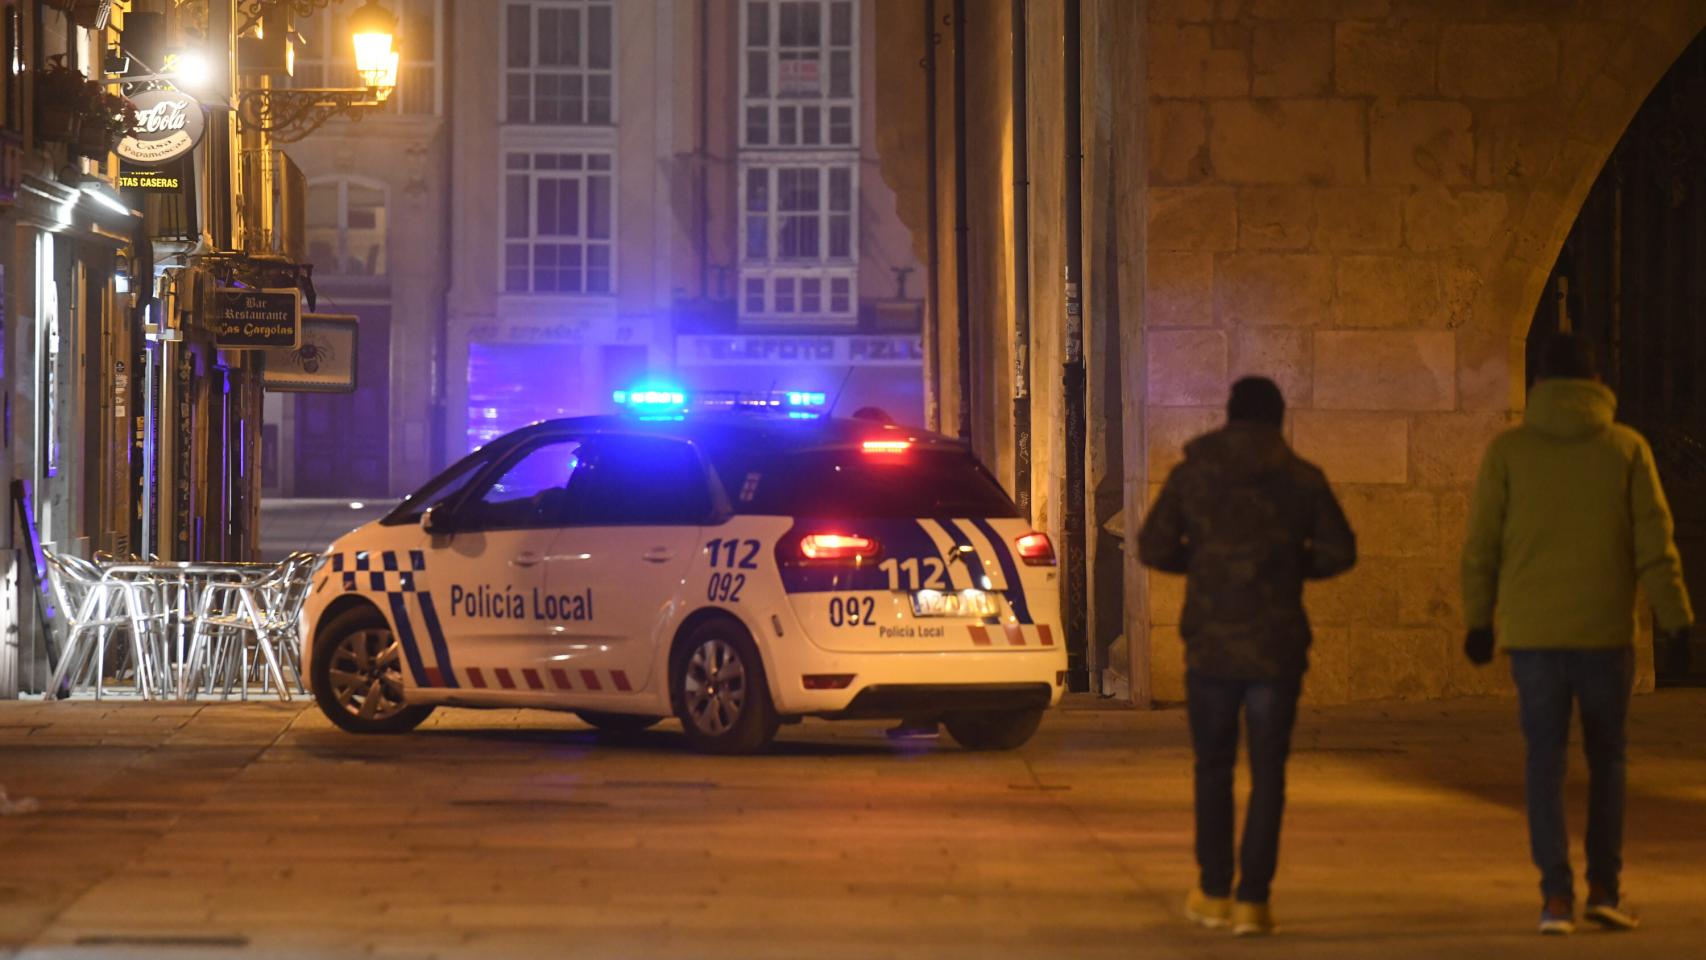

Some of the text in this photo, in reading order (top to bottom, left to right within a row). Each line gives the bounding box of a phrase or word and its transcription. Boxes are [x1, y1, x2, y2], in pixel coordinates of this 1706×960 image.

[136, 140, 172, 150] Casa
[140, 177, 178, 188] CASERAS
[246, 297, 267, 309] Bar
[224, 308, 288, 320] Restaurante
[243, 322, 293, 338] Gargolas
[705, 538, 761, 570] 112
[878, 557, 947, 590] 112
[707, 572, 746, 602] 092
[451, 584, 593, 621] Policía Local
[829, 596, 877, 627] 092
[918, 626, 944, 637] Local
